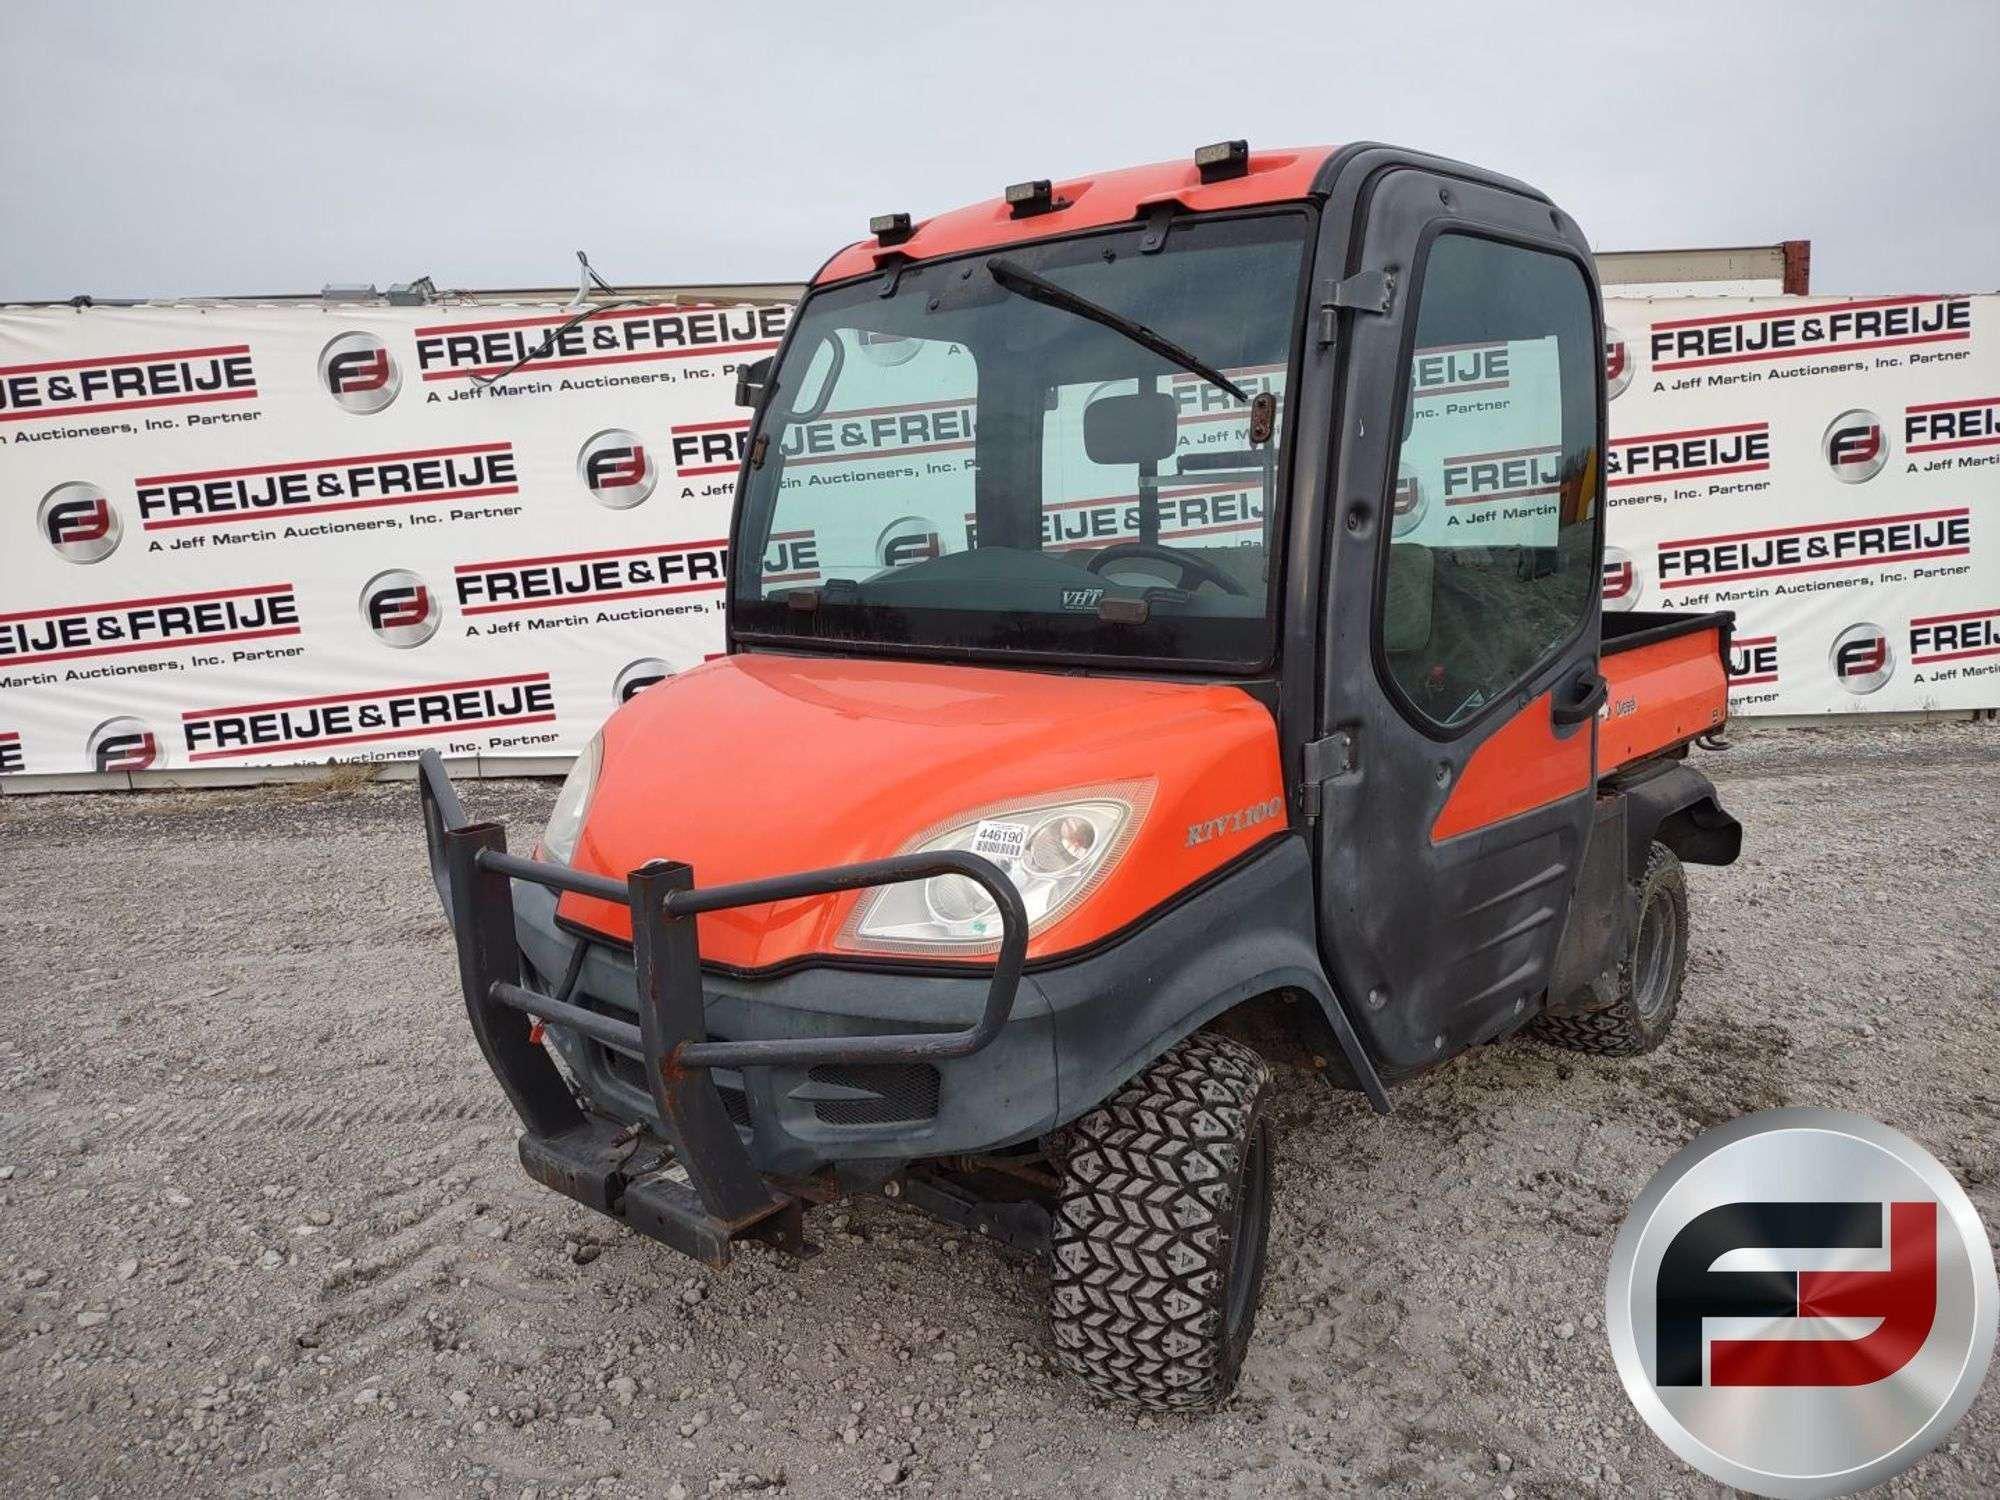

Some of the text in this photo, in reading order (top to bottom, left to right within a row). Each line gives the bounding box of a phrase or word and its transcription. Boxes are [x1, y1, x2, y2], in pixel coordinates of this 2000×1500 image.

[625, 307, 786, 350] FREIJE
[1651, 319, 1796, 361] FREIJE
[1830, 301, 1971, 342] FREIJE
[948, 344, 961, 356] A
[1411, 349, 1510, 387] EIJE
[80, 356, 256, 401] FREIJE
[426, 391, 442, 404] A
[448, 385, 483, 402] Jeff
[490, 380, 553, 398] Martin
[559, 370, 677, 391] Auctioneers,
[683, 365, 715, 379] Inc.
[1653, 349, 1971, 393] A Jeff Martin Auctioneers, Inc. Partner
[1446, 400, 1511, 416] Partner
[1905, 408, 2000, 443] FREI
[15, 424, 138, 445] Auctioneers,
[145, 417, 180, 431] Inc.
[187, 409, 263, 427] Partner
[870, 410, 977, 447] FREI
[1178, 435, 1190, 446] A
[1197, 430, 1230, 444] Jeff
[1626, 432, 1770, 475] FREIJE
[1906, 454, 2000, 473] A Jeff Marti
[136, 473, 311, 519] FREIJE
[348, 452, 518, 497] FREIJE
[680, 487, 694, 499] A
[701, 483, 735, 497] Jeff
[808, 467, 920, 486] Auctioneers,
[926, 463, 957, 475] Inc.
[1444, 455, 1561, 496] FREIJ
[1674, 488, 1702, 500] Inc.
[1708, 480, 1771, 496] Partner
[148, 504, 523, 552] A Jeff Martin Auctioneers, Inc. Partner
[1447, 505, 1558, 527] A Jeff Martin
[1658, 537, 1801, 579] FREIJE
[1833, 517, 1971, 559] FREIJE
[456, 561, 623, 605] FREIJE
[1661, 564, 1971, 609] A Jeff Martin Auctioneers, Inc. Partner
[0, 616, 92, 656] EIJE
[128, 594, 300, 639] FREIJE
[466, 625, 481, 637] A
[486, 620, 521, 636] Jeff
[528, 614, 590, 632] Martin
[595, 603, 710, 624] Auctioneers,
[65, 659, 185, 682] Auctioneers,
[191, 655, 226, 668] Inc.
[232, 645, 306, 664] Partner
[1913, 663, 2000, 684] A Jeff Marti
[183, 705, 354, 751] FREIJE
[389, 682, 555, 728] FREIJE
[1729, 691, 1780, 706] artner
[450, 739, 482, 754] Inc.
[488, 731, 561, 748] Partner
